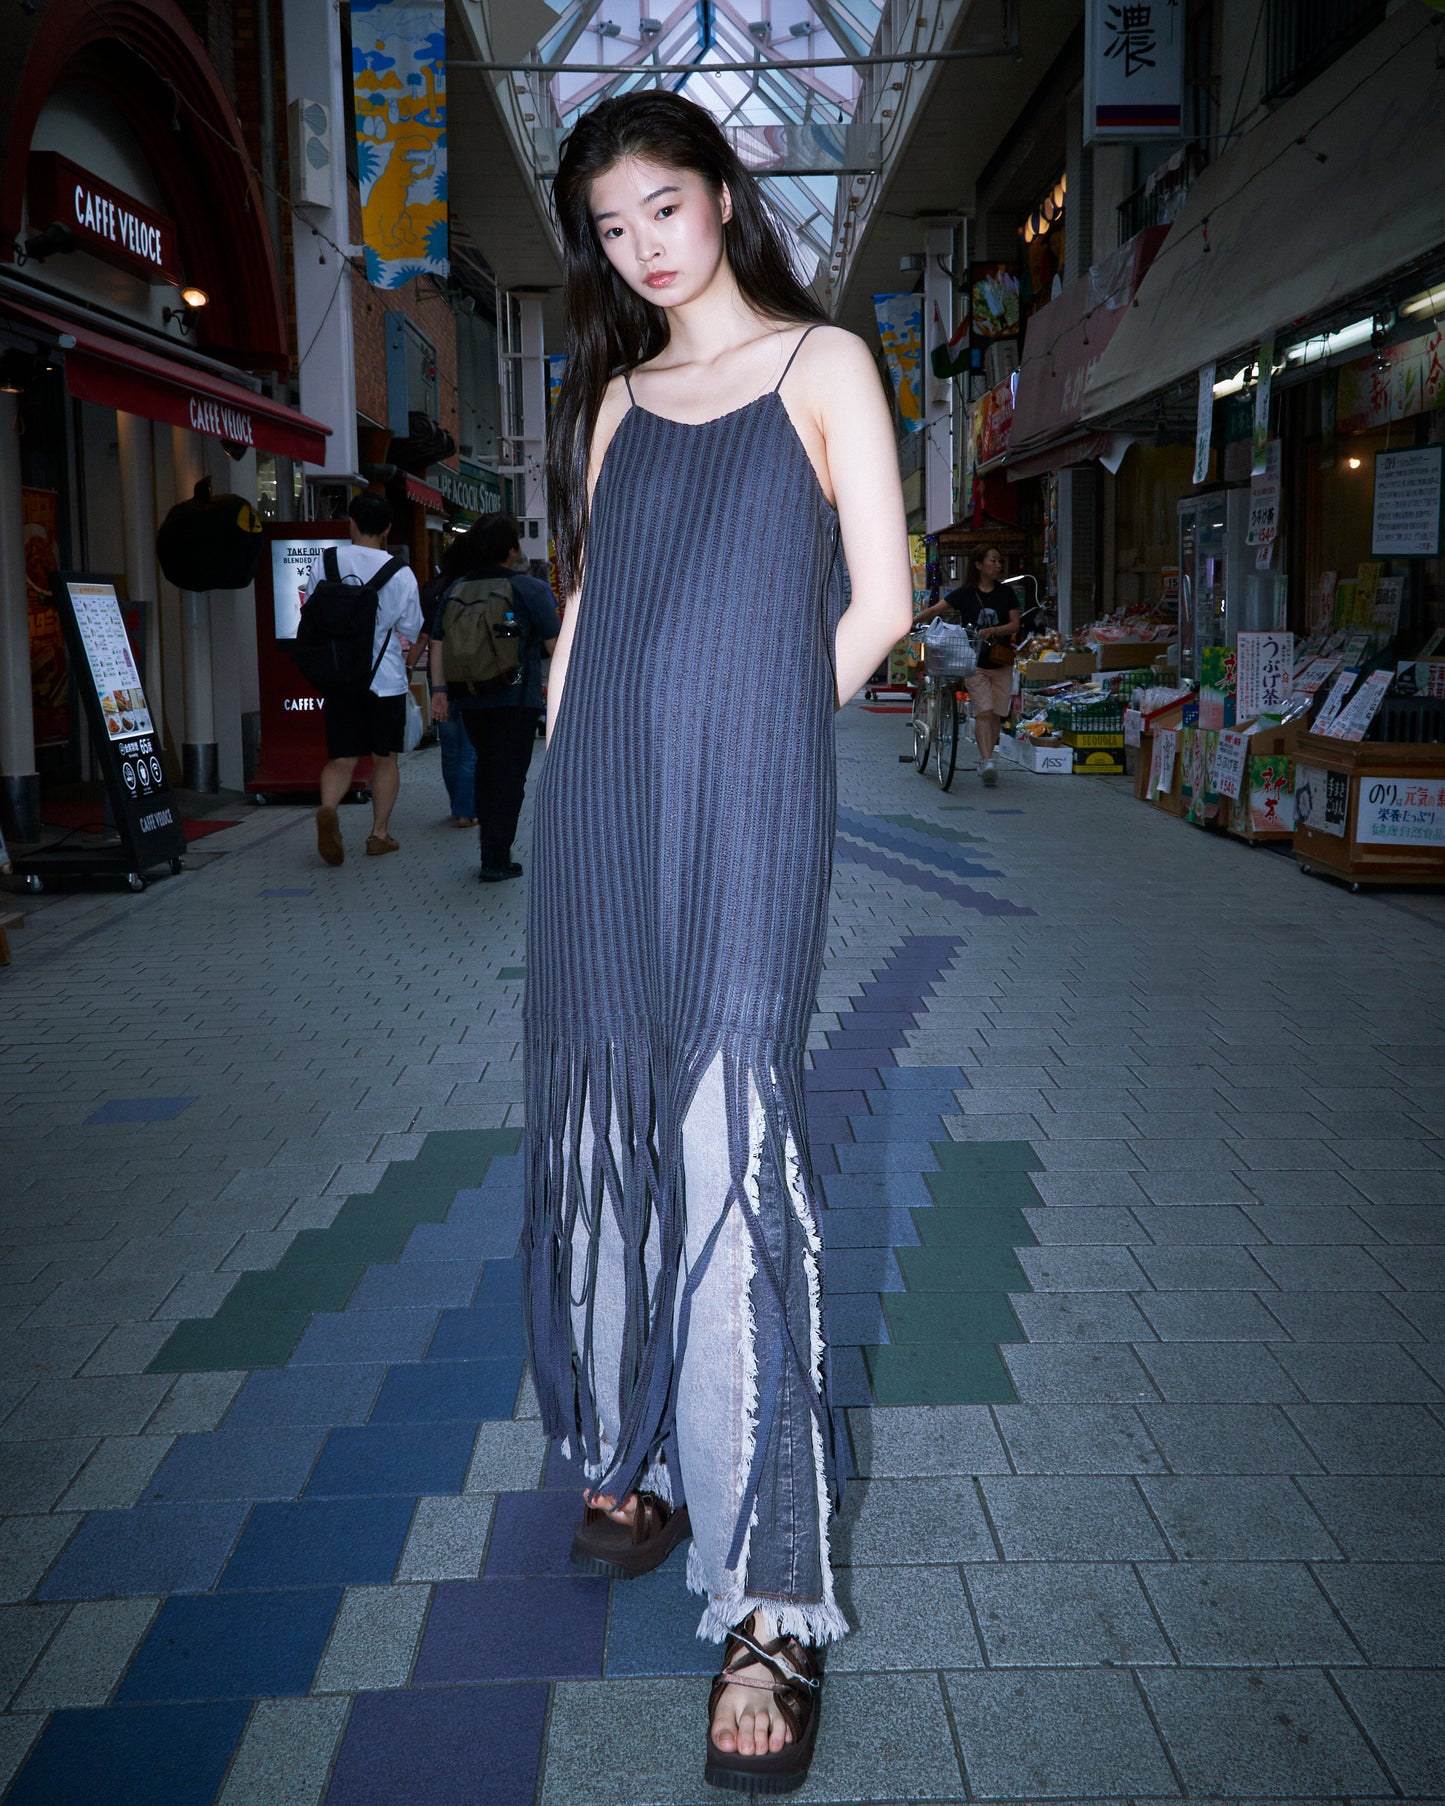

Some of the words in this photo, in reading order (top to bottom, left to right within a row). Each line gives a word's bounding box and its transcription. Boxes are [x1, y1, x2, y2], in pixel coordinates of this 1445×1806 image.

[1104, 3, 1156, 77] 濃
[74, 184, 117, 242] CAFFÈ
[117, 207, 163, 266] VELOCE
[220, 406, 254, 445] VELOCE
[441, 475, 479, 513] PEACOCK
[287, 548, 308, 556] TAKE
[1262, 636, 1281, 706] うぶげ茶
[283, 697, 315, 711] CAFFÈ
[1082, 735, 1119, 746] SEQUOIA
[1378, 808, 1435, 825] 栄養たっぷり
